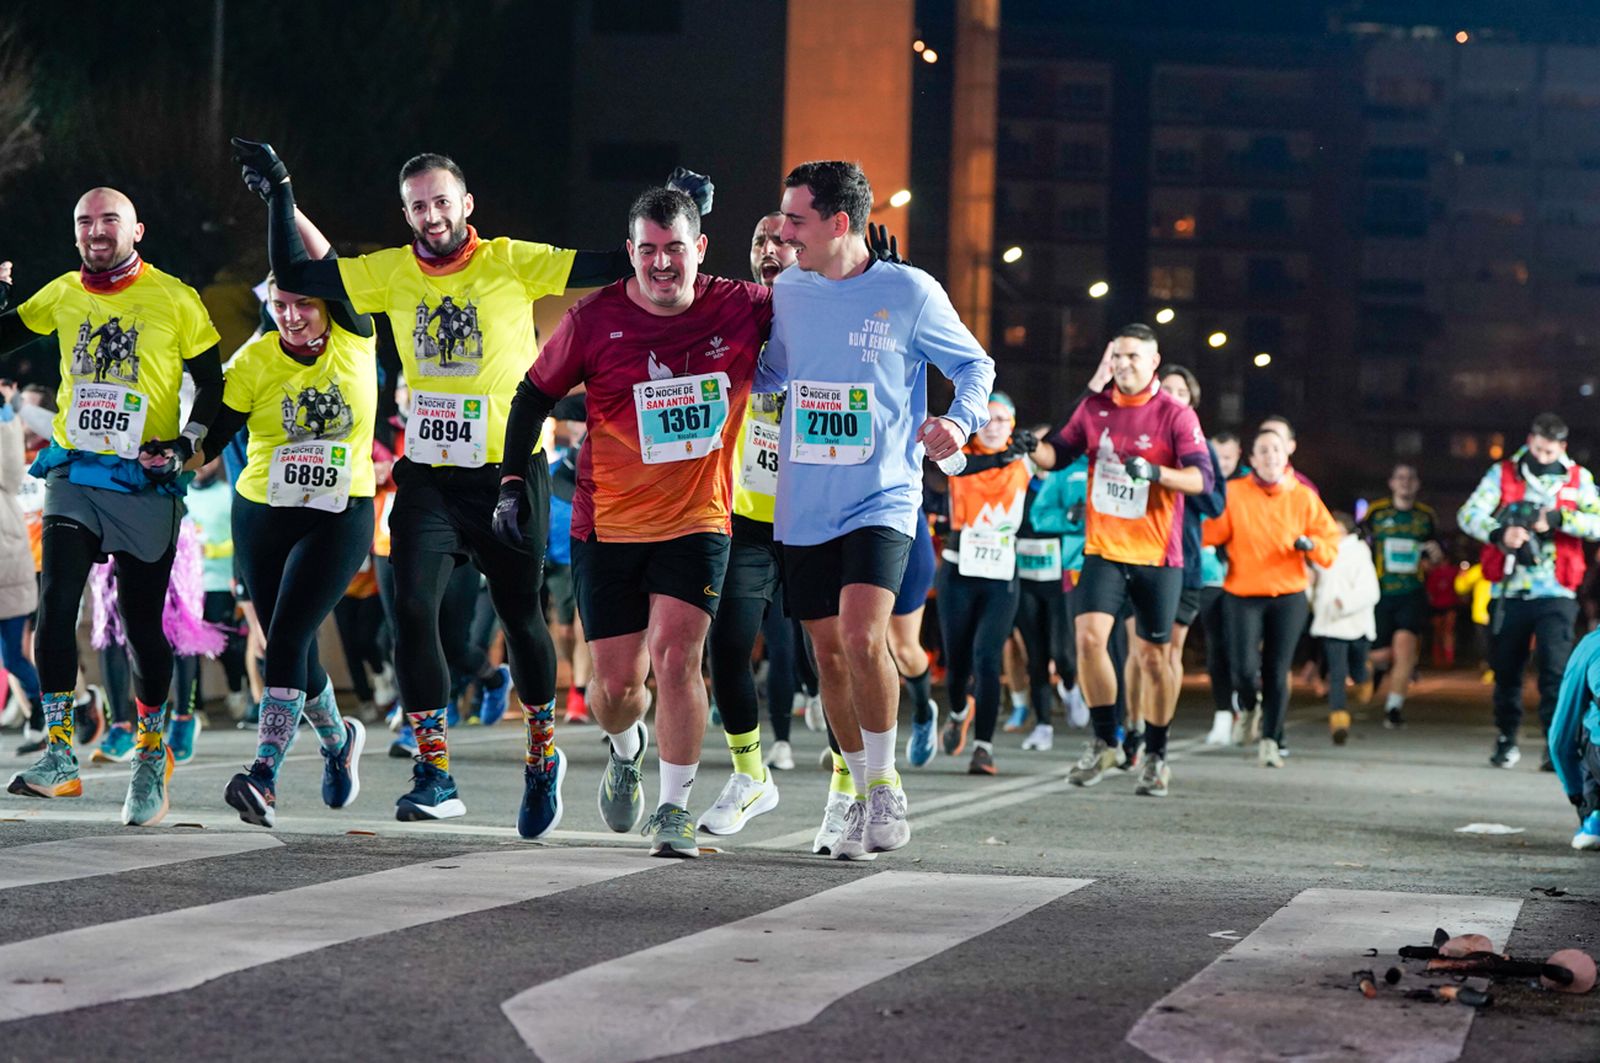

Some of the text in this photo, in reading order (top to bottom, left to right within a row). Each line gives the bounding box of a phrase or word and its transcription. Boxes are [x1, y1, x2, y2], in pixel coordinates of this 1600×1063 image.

[848, 332, 896, 352] RUN BERLIN
[87, 391, 118, 401] NOCHE DE
[655, 387, 682, 398] NOCHE
[683, 385, 694, 394] DE
[809, 390, 831, 400] NOCHE
[831, 391, 841, 401] DE
[78, 400, 91, 408] SAN
[424, 400, 456, 409] NOCHE DE
[646, 399, 664, 410] SAN
[666, 395, 695, 408] ANTÓN
[800, 399, 814, 410] SAN
[416, 408, 429, 416] SAN
[79, 408, 131, 432] 6895
[658, 404, 711, 434] 1367
[807, 411, 857, 437] 2700
[419, 417, 472, 443] 6894
[762, 431, 779, 441] NOCH
[753, 437, 778, 451] SAN AN
[824, 437, 840, 445] David
[290, 447, 324, 455] NOCHE DE
[280, 455, 296, 463] SAN
[757, 449, 779, 472] 43
[284, 463, 338, 487] 6893
[1107, 482, 1134, 501] 1021
